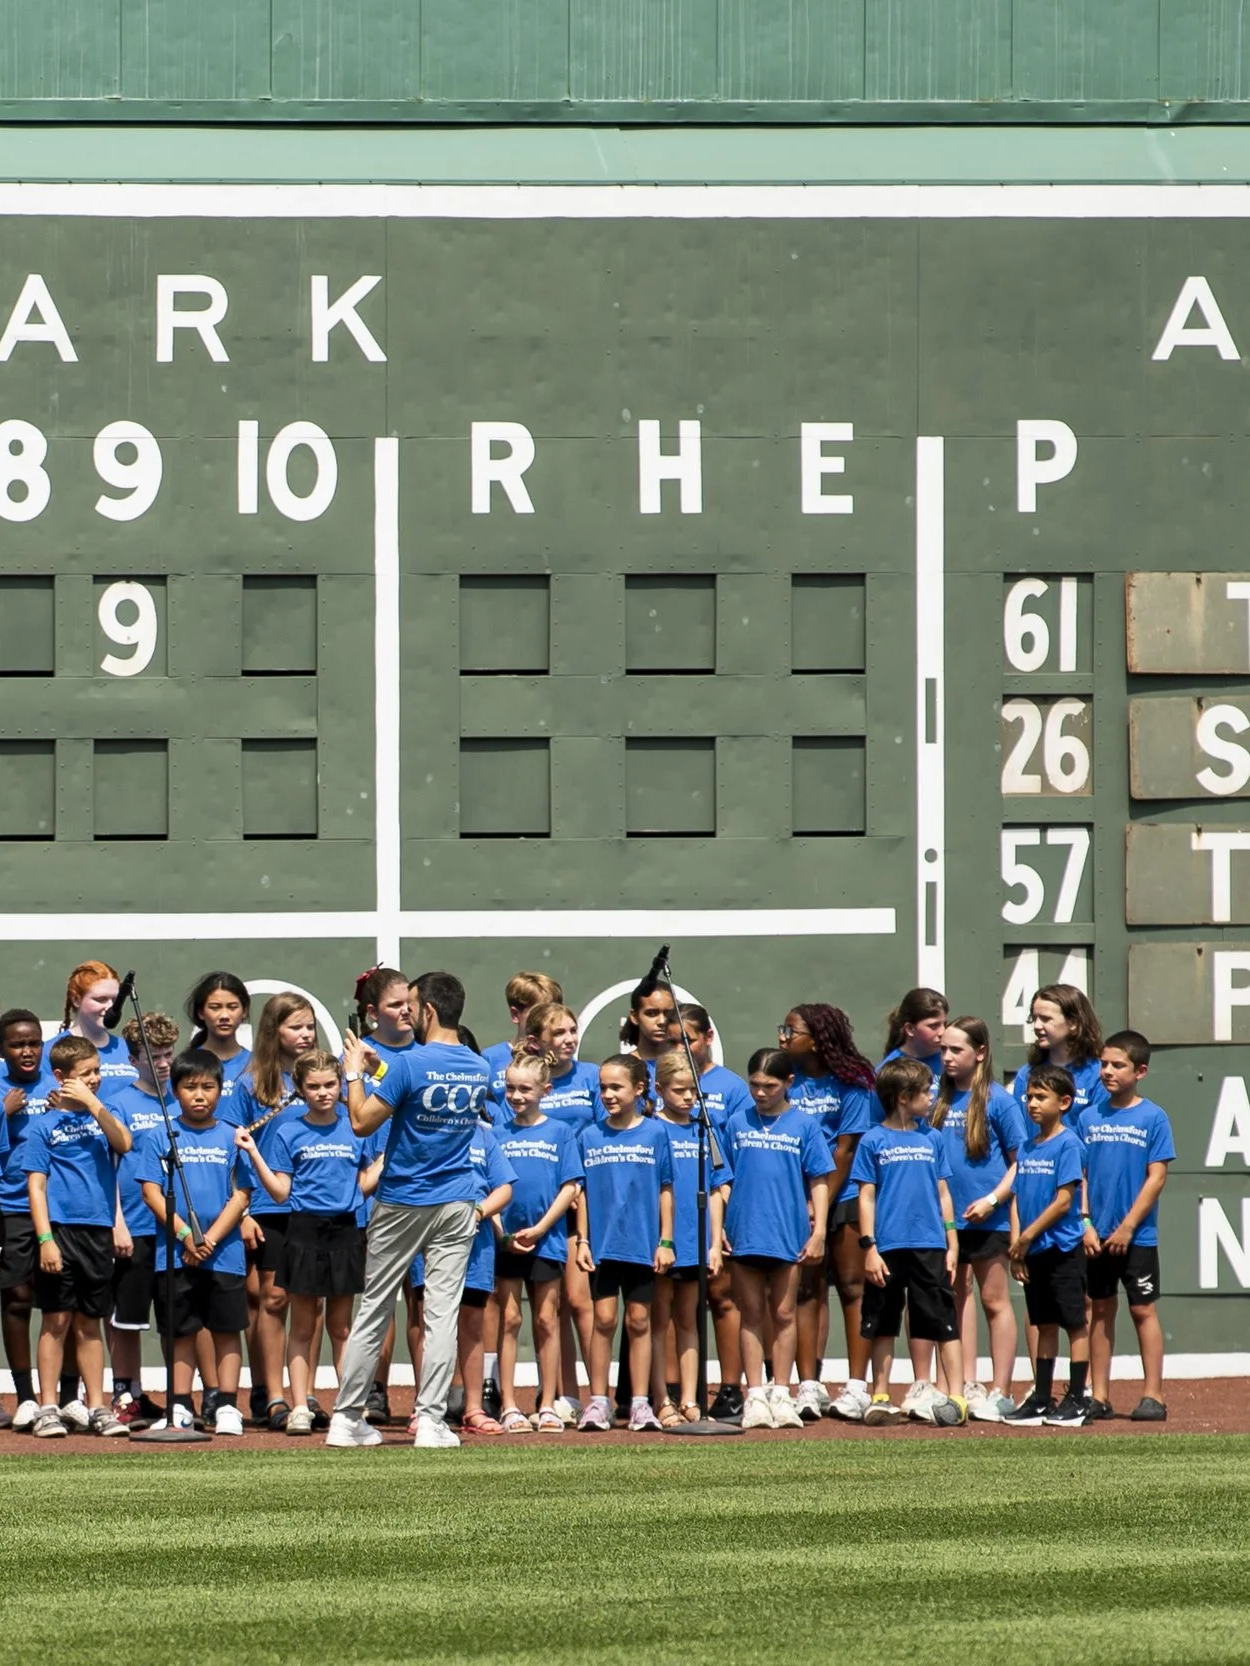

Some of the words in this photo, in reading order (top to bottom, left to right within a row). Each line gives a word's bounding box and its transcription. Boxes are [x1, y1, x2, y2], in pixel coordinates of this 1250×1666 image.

[1152, 275, 1240, 361] A
[93, 420, 162, 522] 9
[238, 420, 338, 522] 10
[471, 421, 535, 514] R
[639, 420, 702, 514] H
[801, 422, 854, 514] E
[1017, 420, 1078, 513] P
[98, 581, 158, 677] 9
[1004, 578, 1078, 672] 61
[1001, 698, 1090, 794] 26
[1001, 828, 1090, 925] 57
[426, 1071, 445, 1081] The
[748, 1130, 801, 1146] Chelmsford
[1100, 1123, 1149, 1139] Chelmsford
[507, 1140, 558, 1153] Chelmsford
[586, 1147, 602, 1158] The
[602, 1143, 655, 1157] Chelmsford
[771, 1141, 801, 1155] Chorus
[528, 1148, 559, 1163] Chorus
[584, 1154, 625, 1169] Children's
[625, 1155, 656, 1166] Chorus
